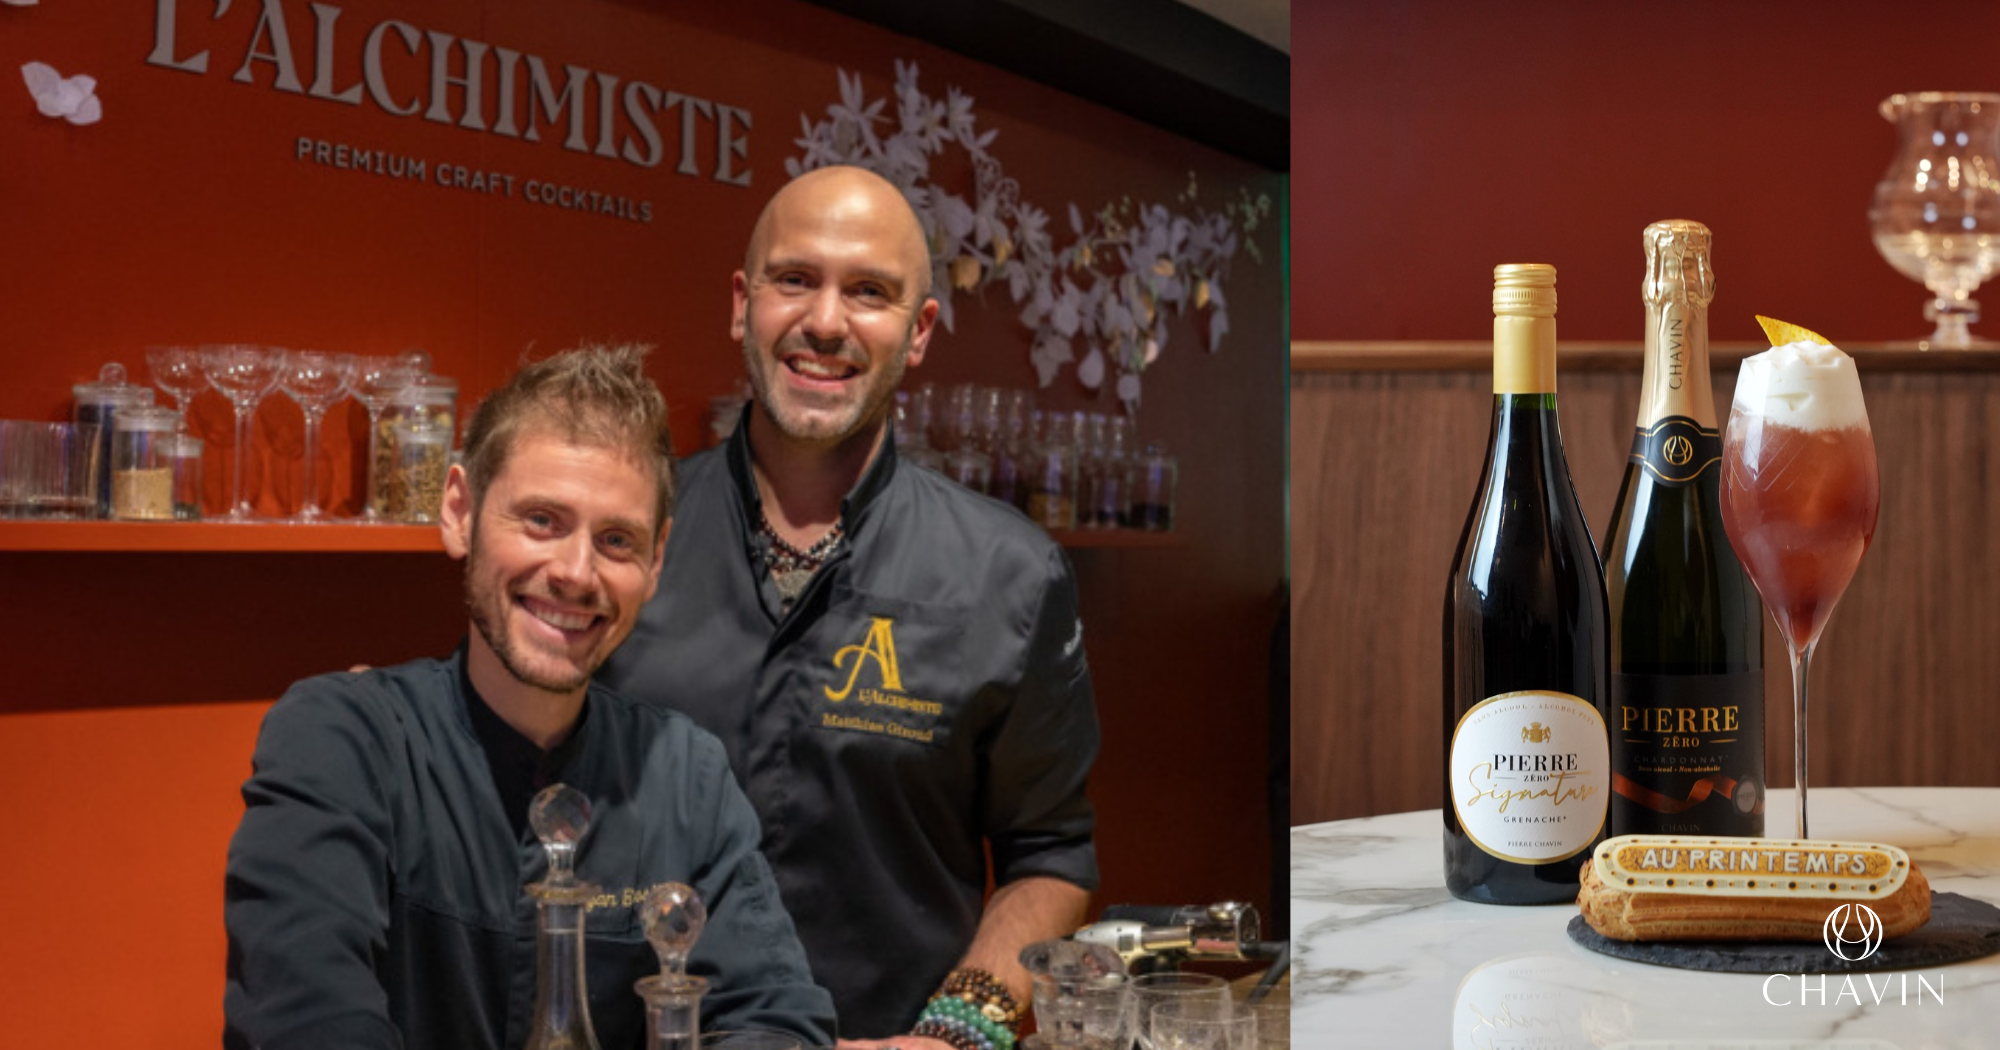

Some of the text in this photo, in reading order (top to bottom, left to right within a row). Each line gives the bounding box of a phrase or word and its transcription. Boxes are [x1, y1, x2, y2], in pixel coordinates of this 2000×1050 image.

[146, 0, 752, 186] L'ALCHIMISTE
[297, 137, 653, 223] PREMIUM CRAFT COCKTAILS
[1669, 318, 1683, 390] CHAVIN
[824, 616, 906, 701] A
[1494, 704, 1527, 715] ALCOOL
[1539, 703, 1576, 715] ALCOHOL
[1621, 705, 1739, 733] PIERRE
[1493, 753, 1578, 772] PIERRE
[1653, 765, 1673, 773] alcool
[1678, 765, 1721, 773] Non-alcoholic
[1468, 761, 1599, 814] Signature
[1661, 823, 1701, 833] CHAVIN
[1508, 840, 1562, 848] PIERRE CHAVIN
[1641, 848, 1866, 874] AU PRINTEMPS
